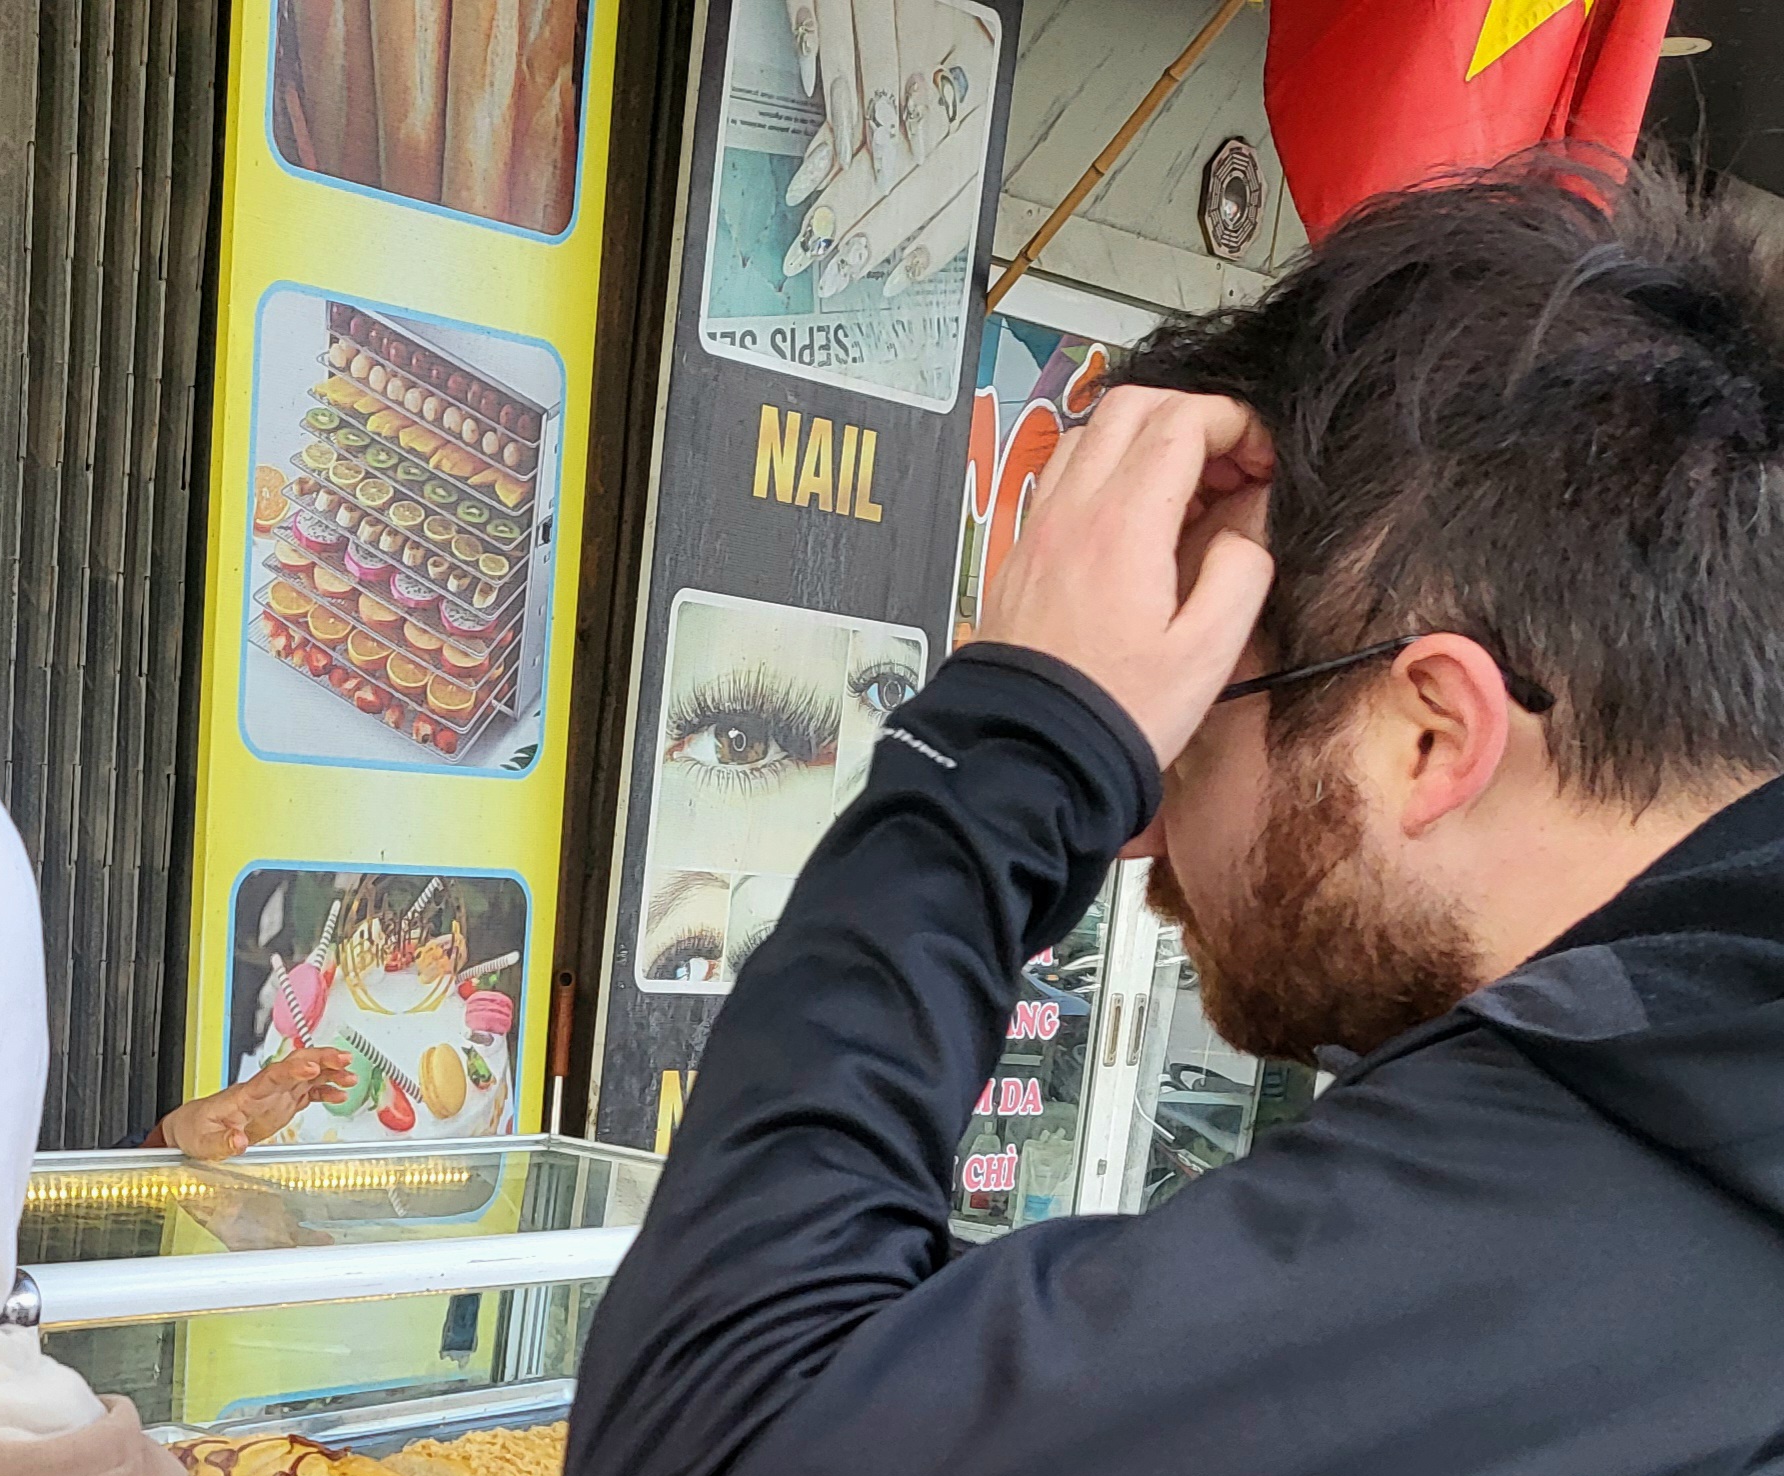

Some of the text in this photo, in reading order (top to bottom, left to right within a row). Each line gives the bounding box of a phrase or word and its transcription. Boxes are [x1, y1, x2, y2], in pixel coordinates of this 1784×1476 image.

[752, 403, 883, 523] NAIL
[998, 1079, 1043, 1114] DA
[964, 1144, 1017, 1190] CHÌ
